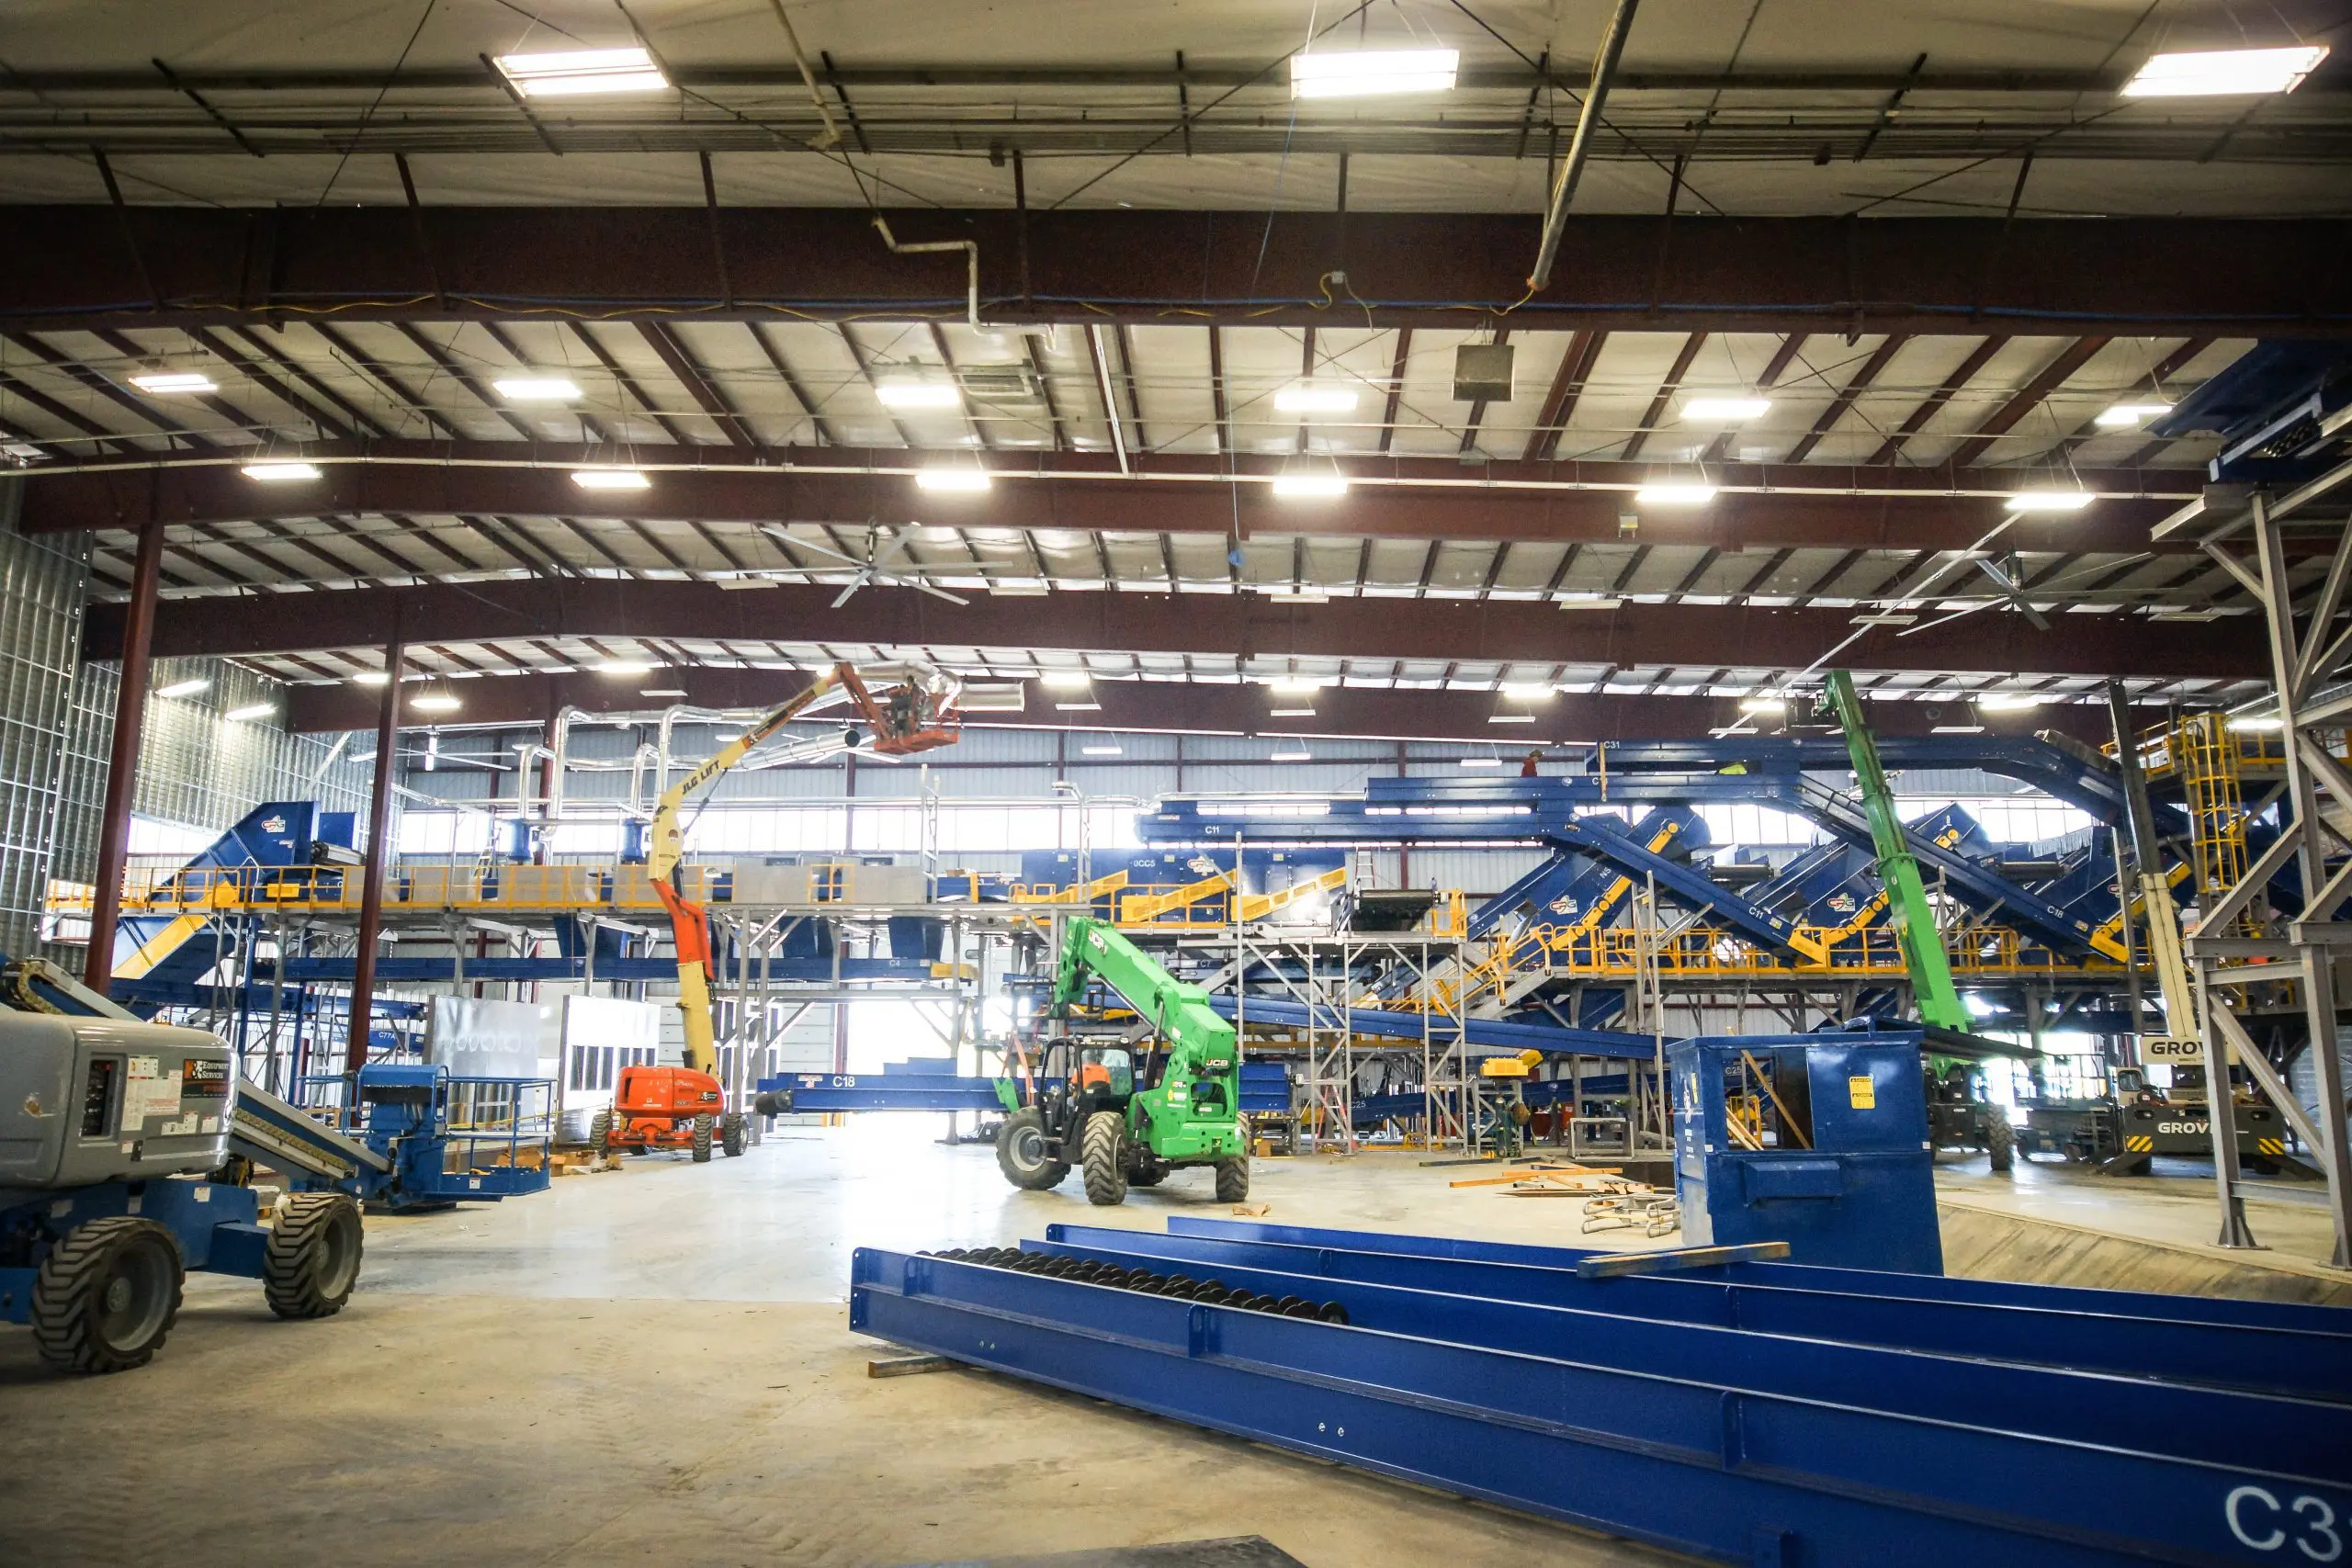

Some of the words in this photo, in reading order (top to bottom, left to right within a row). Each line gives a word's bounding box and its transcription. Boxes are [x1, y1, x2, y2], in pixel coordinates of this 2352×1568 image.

[1603, 740, 1620, 749] C31
[682, 776, 698, 795] JLG
[700, 760, 720, 781] LIFT
[1204, 826, 1220, 835] C11
[1748, 907, 1764, 919] C11
[2046, 905, 2064, 919] C18
[379, 1032, 396, 1040] C77A
[1724, 1066, 1742, 1075] C25
[832, 1076, 855, 1088] C18
[2157, 1122, 2213, 1134] GROV
[2225, 1486, 2352, 1562] C3
